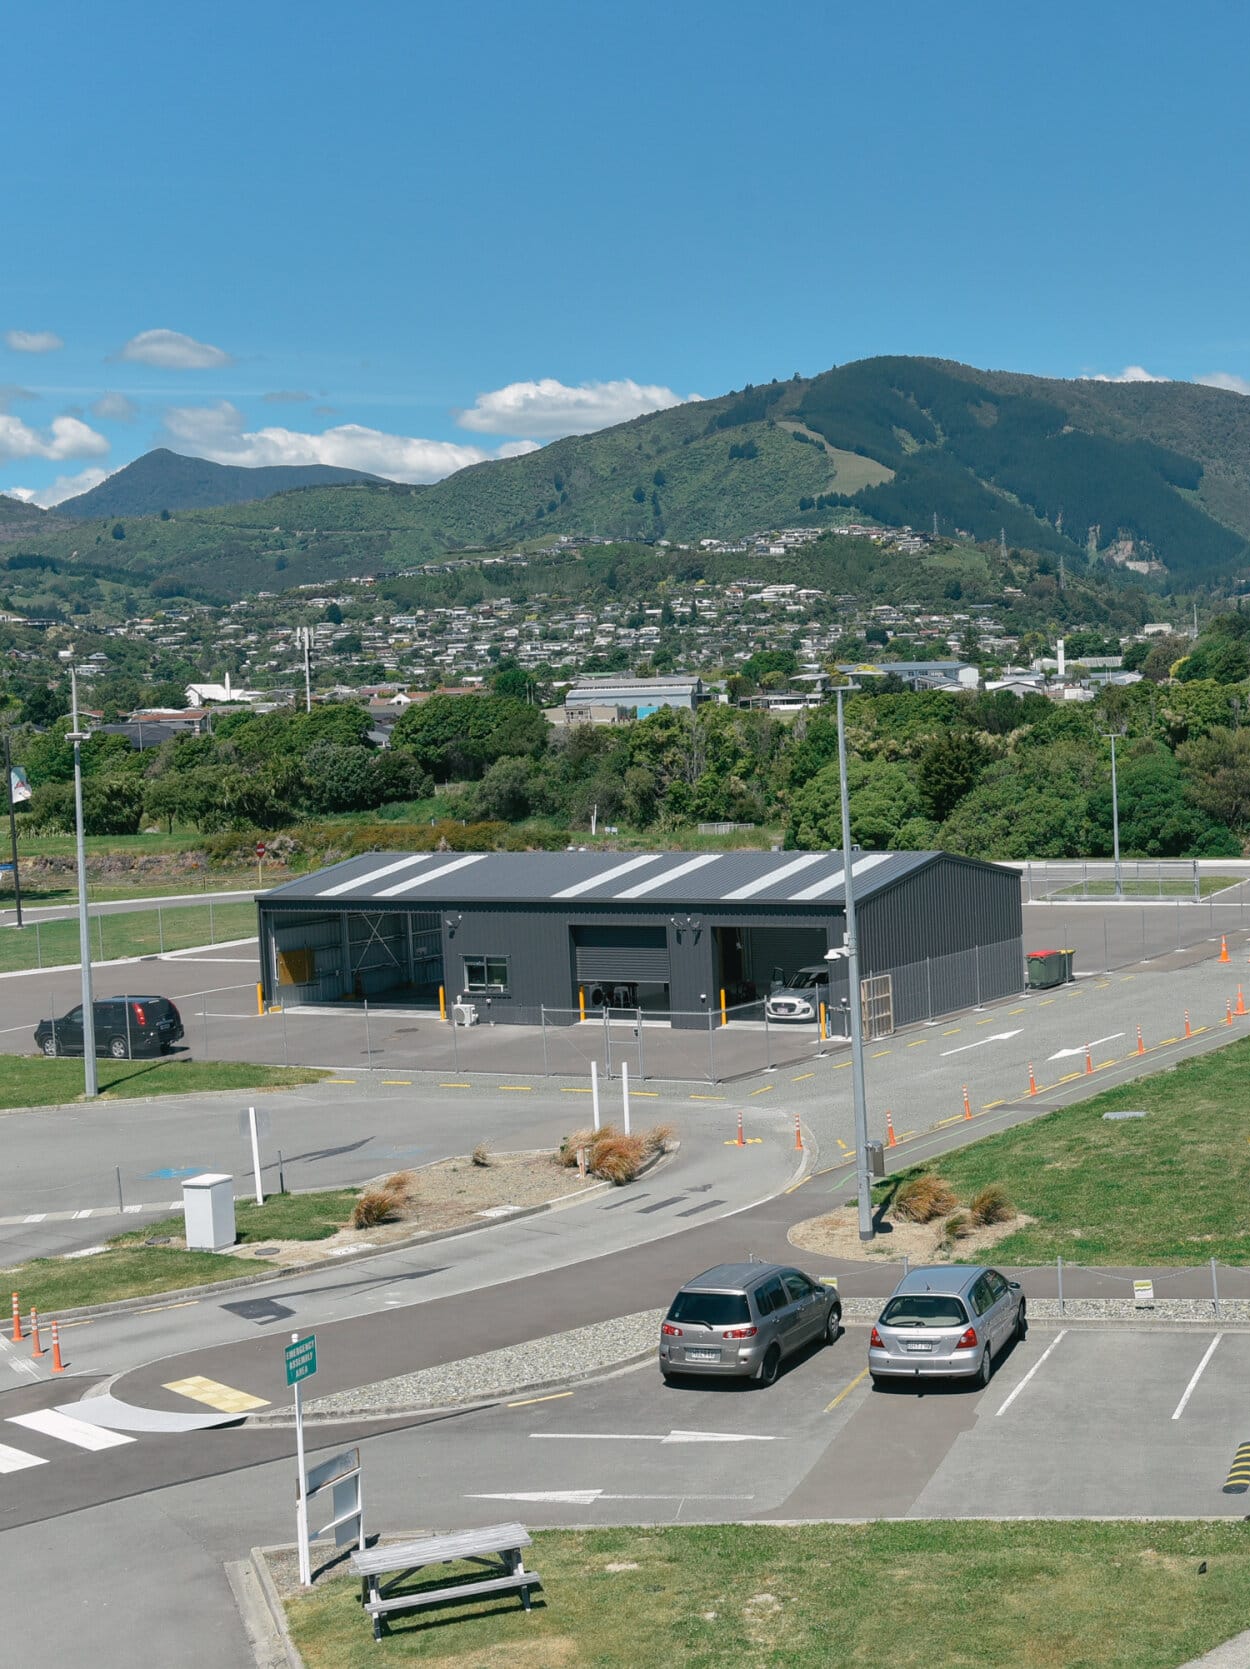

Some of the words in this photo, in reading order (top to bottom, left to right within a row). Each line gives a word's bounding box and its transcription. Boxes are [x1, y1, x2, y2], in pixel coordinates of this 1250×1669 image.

[286, 1340, 314, 1360] EMERGENCY
[290, 1352, 313, 1370] ASSEMBLY
[296, 1365, 308, 1377] AREA
